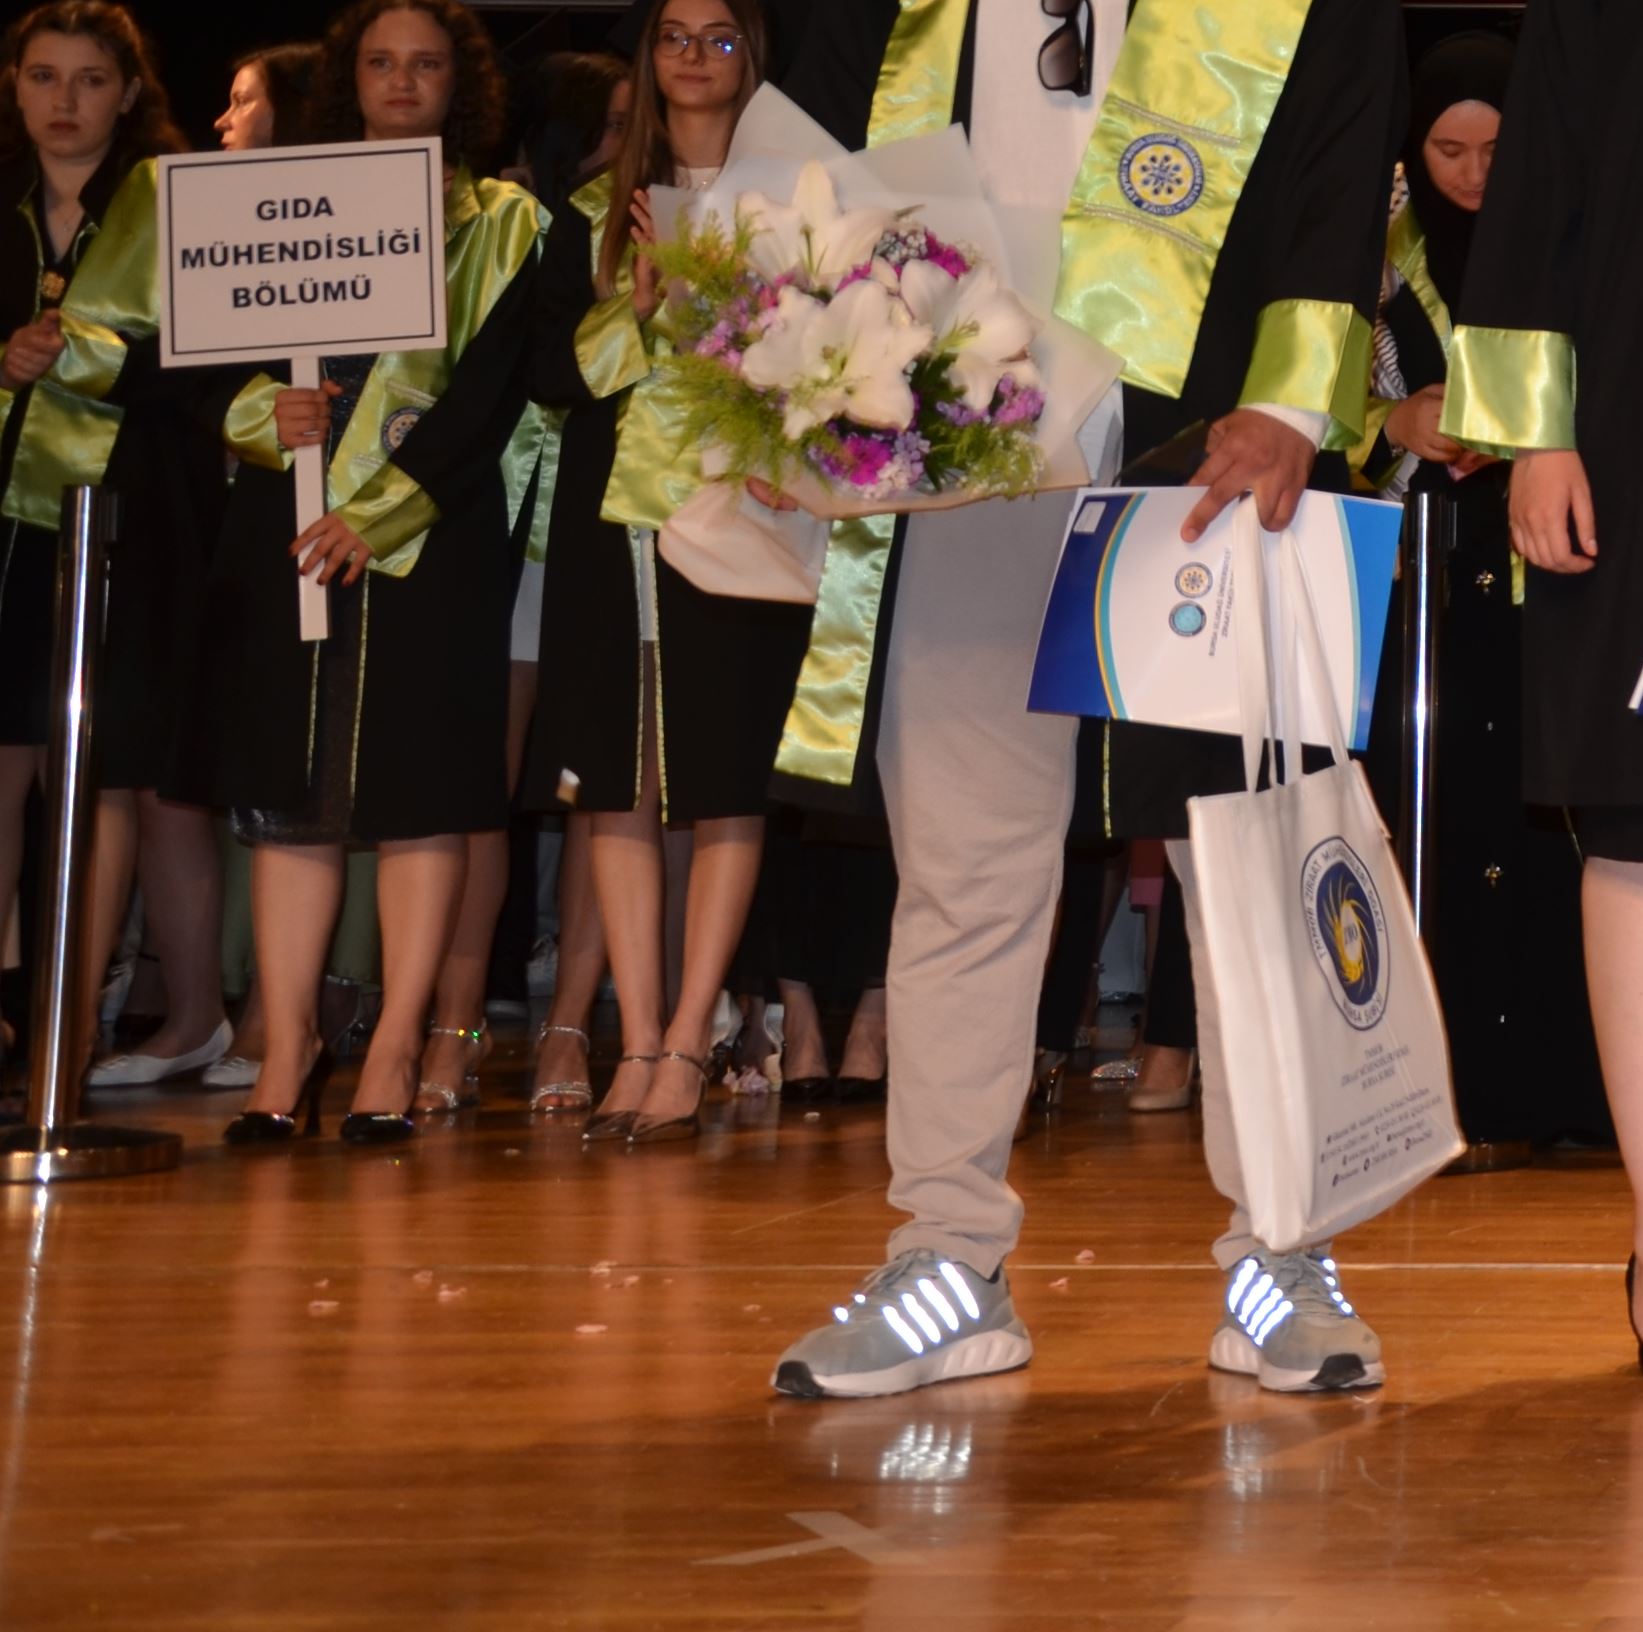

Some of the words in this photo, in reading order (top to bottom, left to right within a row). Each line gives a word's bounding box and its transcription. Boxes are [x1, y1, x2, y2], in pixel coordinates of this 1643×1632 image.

[256, 196, 334, 221] GIDA
[180, 227, 421, 270] MÜHENDİSLİĞİ
[232, 274, 372, 309] BÖLÜMÜ
